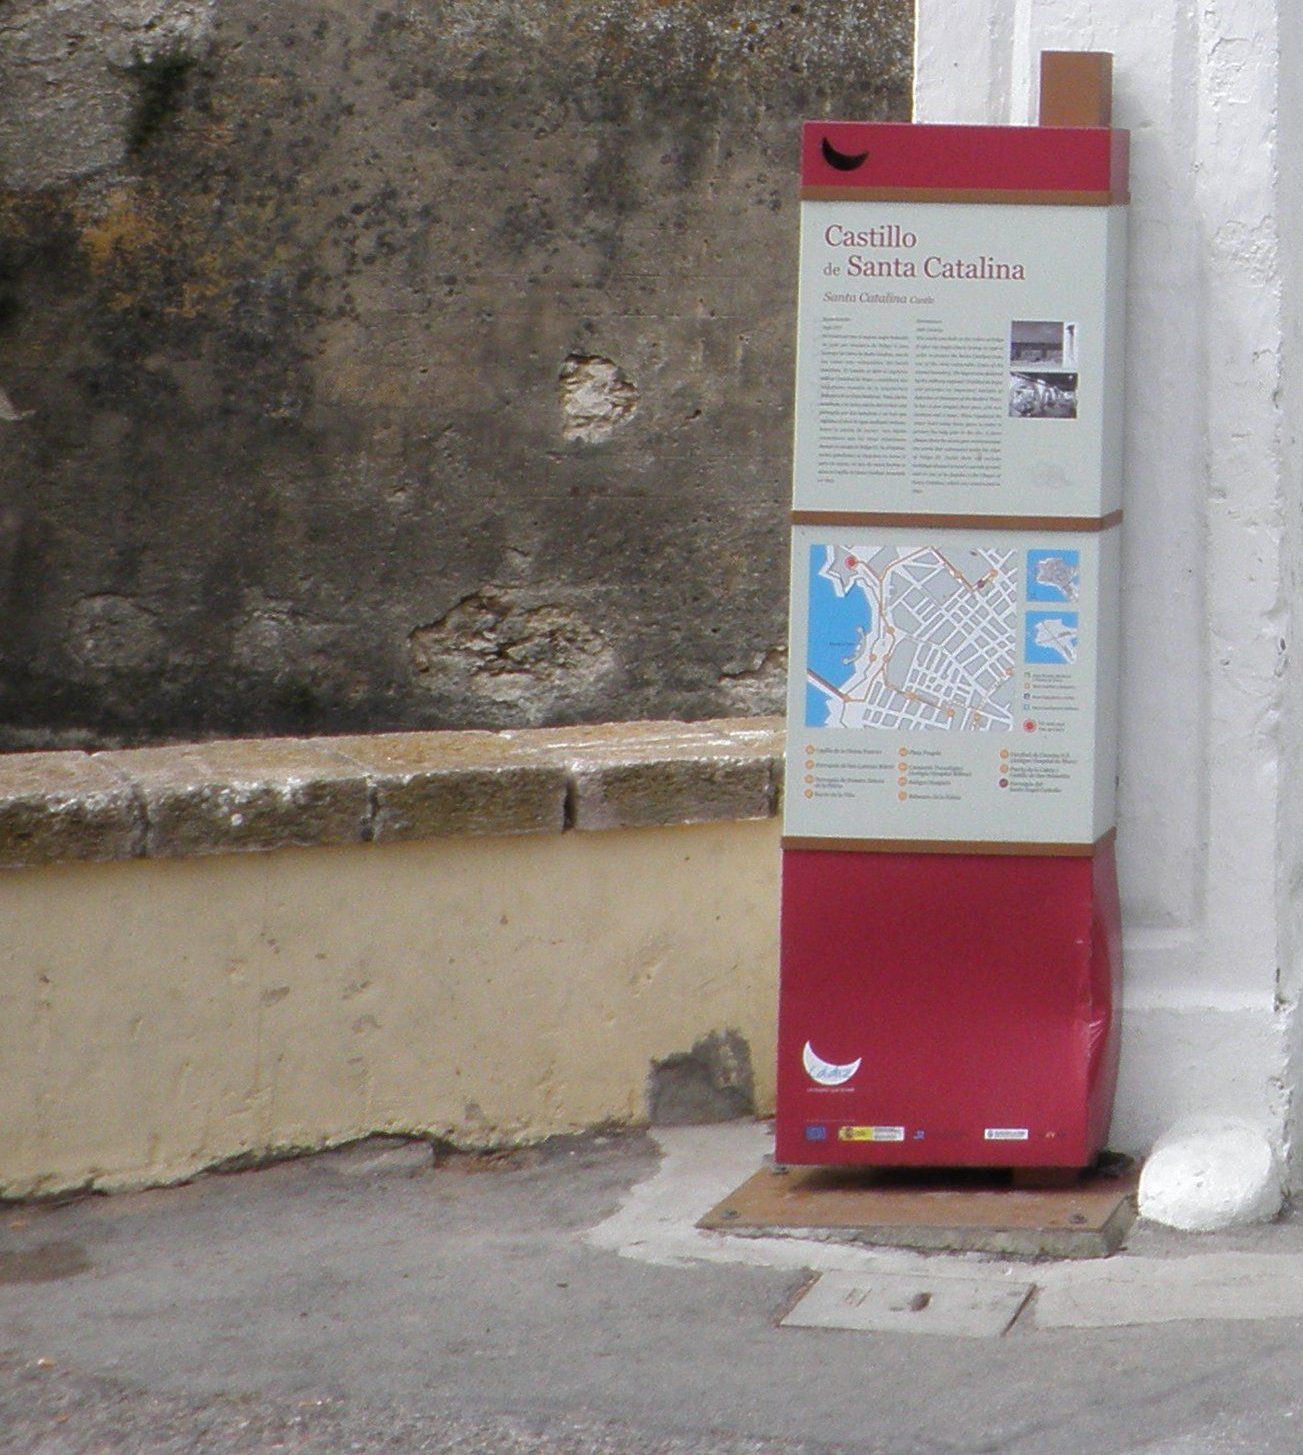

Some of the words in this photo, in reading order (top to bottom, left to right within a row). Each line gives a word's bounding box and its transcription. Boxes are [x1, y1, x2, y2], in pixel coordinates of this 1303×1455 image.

[825, 224, 917, 248] Castillo
[823, 263, 840, 276] de
[847, 255, 916, 278] Santa
[924, 256, 1025, 280] Catalina
[823, 291, 857, 303] Santa
[859, 292, 907, 304] Catalina
